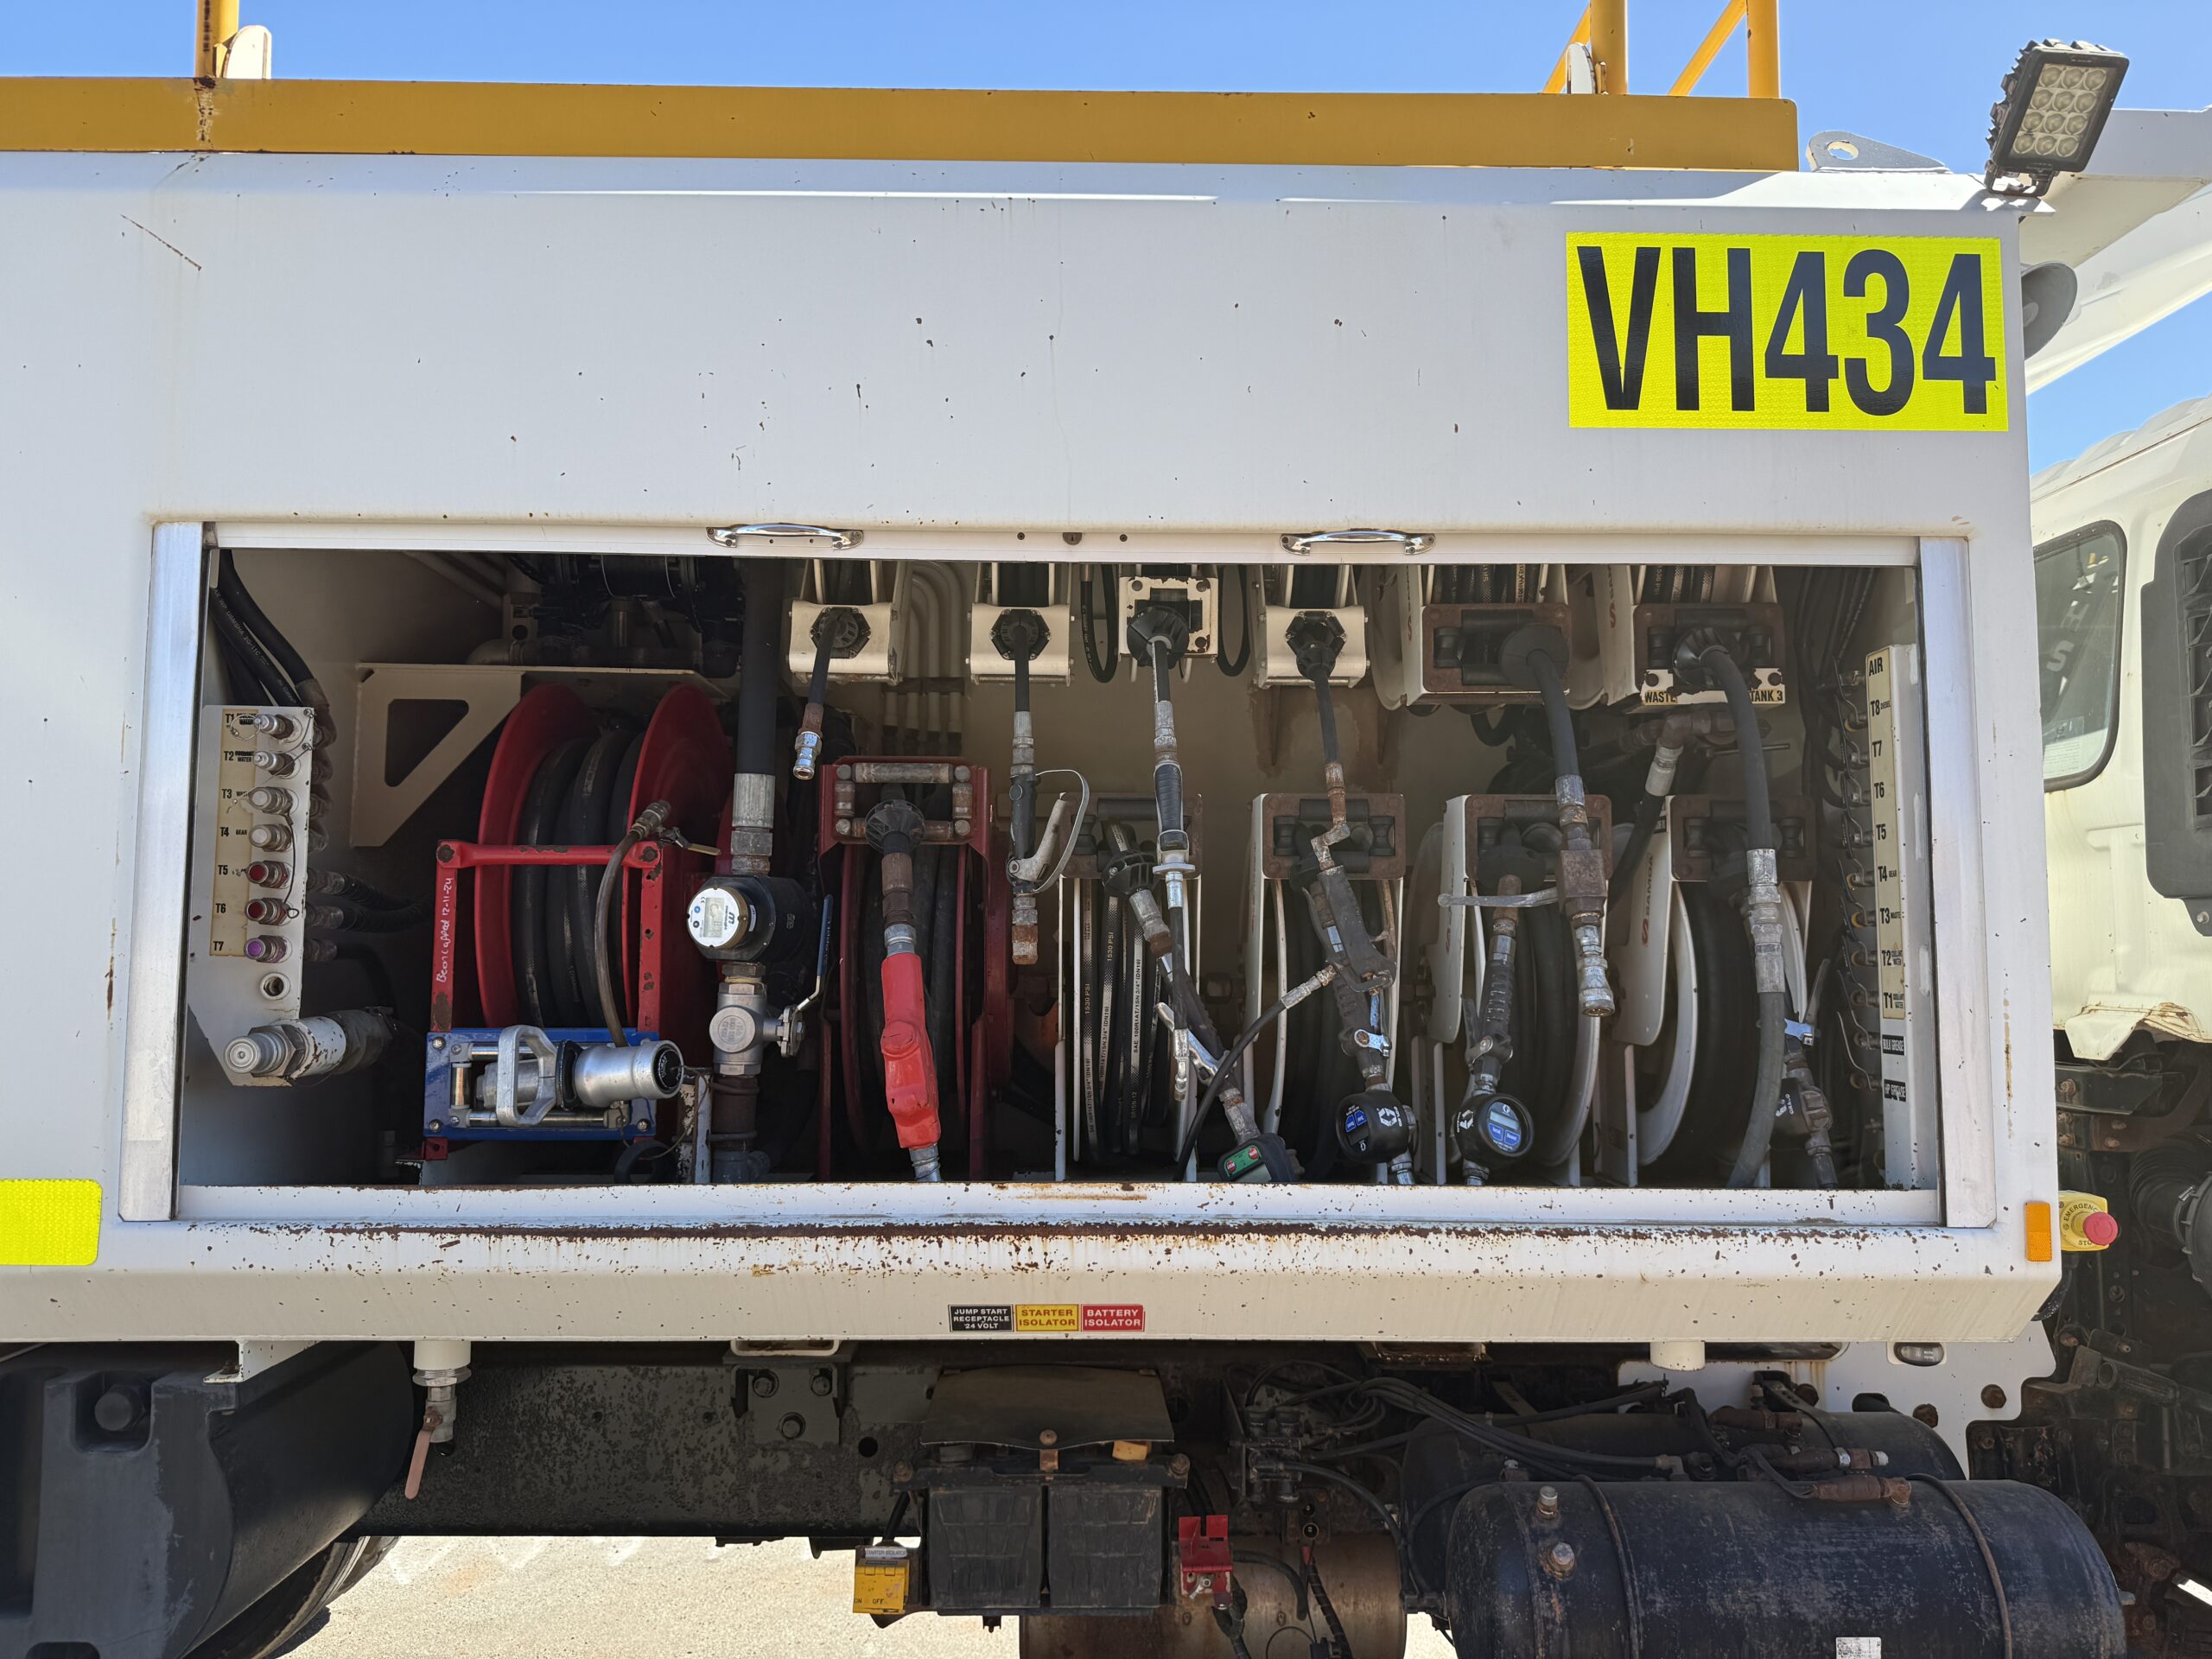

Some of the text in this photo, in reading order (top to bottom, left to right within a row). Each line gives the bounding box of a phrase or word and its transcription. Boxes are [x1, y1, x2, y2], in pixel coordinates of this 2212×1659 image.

[1577, 246, 1996, 416] VH434
[1869, 657, 1884, 677] AIR
[1644, 690, 1783, 702] WASTE TANK 3
[1870, 699, 1880, 717] T8
[225, 713, 234, 724] T1
[223, 751, 234, 761] T2
[1872, 740, 1882, 758] T7
[221, 788, 232, 799] T3
[1874, 781, 1885, 799] T6
[219, 826, 230, 837] T4
[1876, 823, 1886, 841] T5
[218, 865, 228, 875] T5
[1878, 865, 1897, 882] T4 GEAR
[442, 877, 454, 916] 12-11-24
[215, 903, 226, 913] T6
[1879, 907, 1891, 924] T3
[213, 940, 225, 951] T7
[1881, 950, 1891, 966] T2
[1884, 992, 1893, 1009] T1
[1882, 1039, 1904, 1052] BULK GREASE
[2064, 1203, 2098, 1222] EMERGENC
